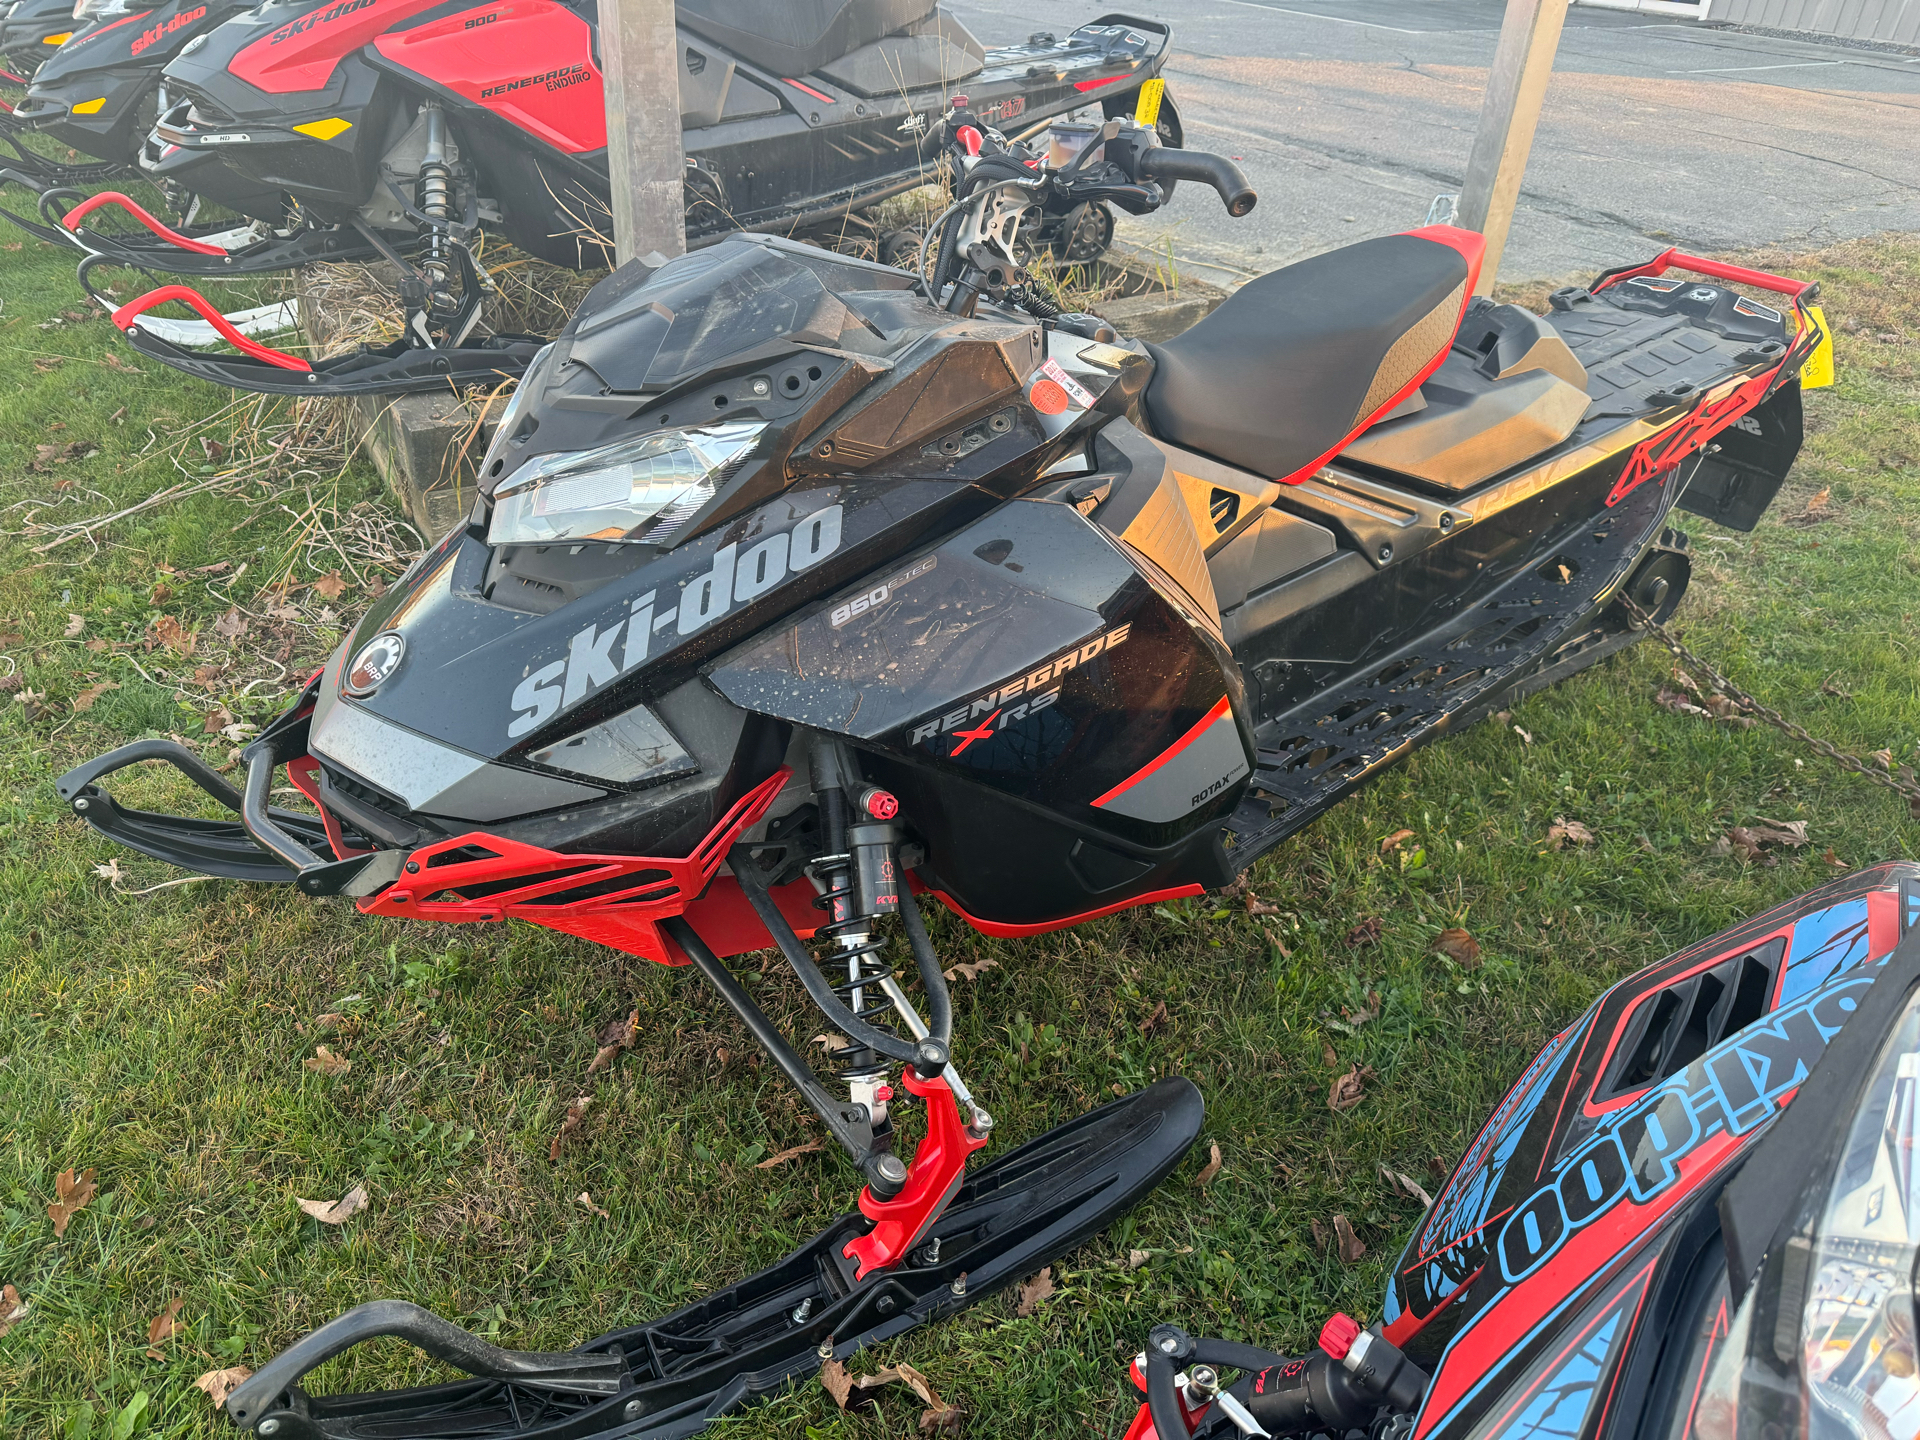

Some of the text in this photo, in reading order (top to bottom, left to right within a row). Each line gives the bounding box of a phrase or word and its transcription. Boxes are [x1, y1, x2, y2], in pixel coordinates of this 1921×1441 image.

[131, 6, 207, 57] ski-doo
[270, 0, 377, 45] ski-doo
[465, 13, 498, 30] 900
[481, 63, 584, 99] RENEGADE
[545, 71, 592, 93] ENDURO
[830, 559, 933, 627] 850 E-TEC
[507, 504, 843, 738] ski-doo
[363, 661, 383, 681] BRP
[911, 621, 1132, 746] RENEGADE
[1191, 773, 1230, 807] ROTAX
